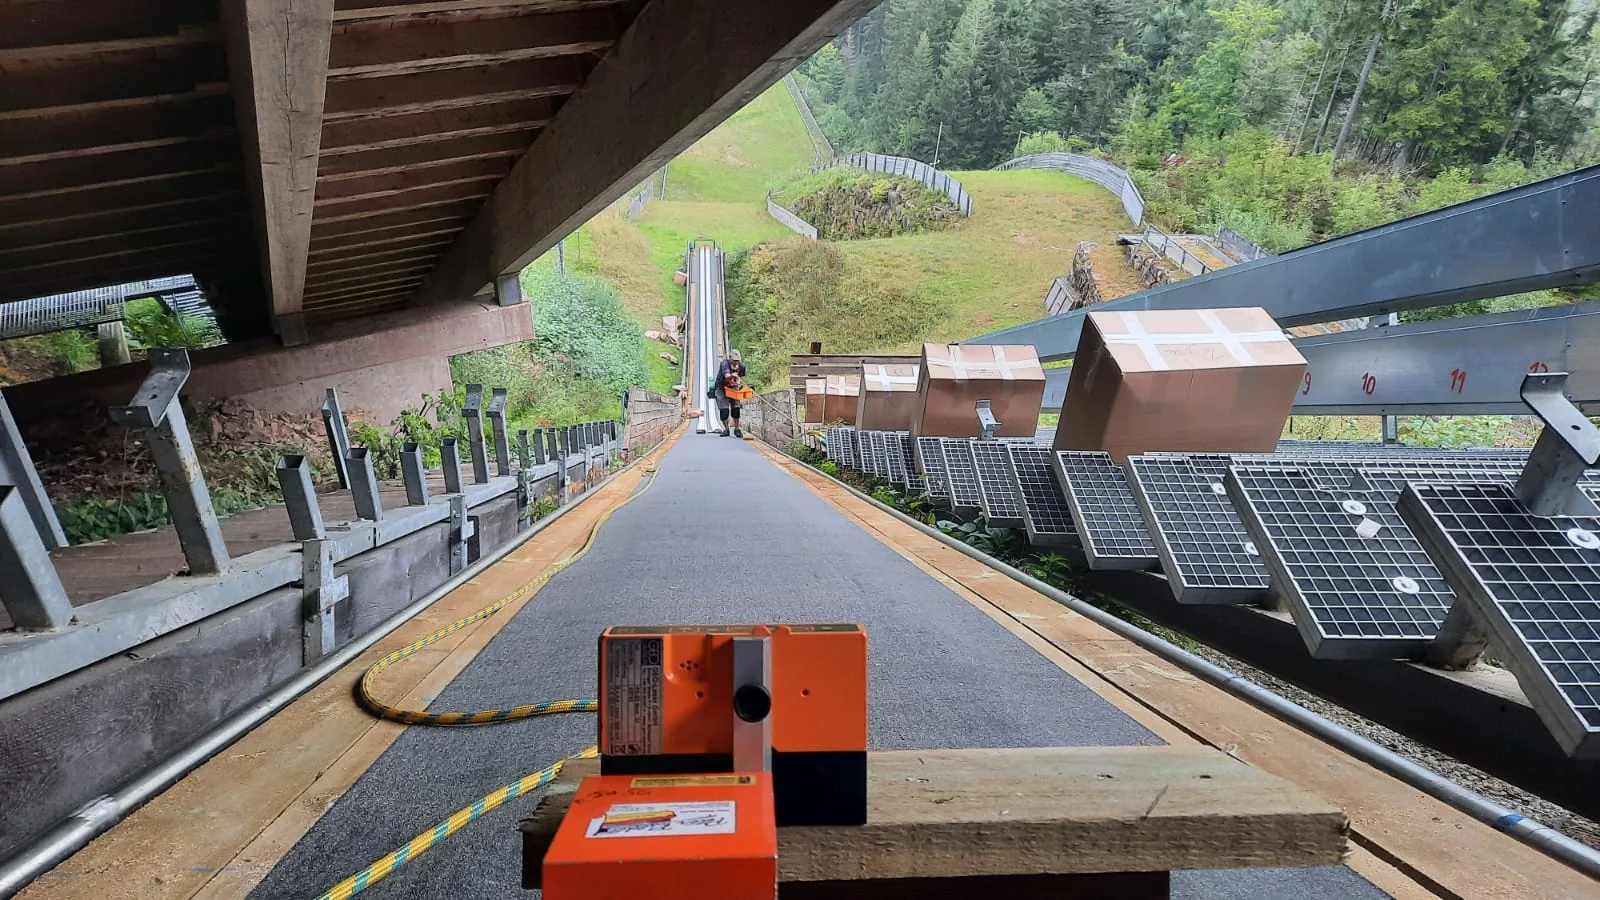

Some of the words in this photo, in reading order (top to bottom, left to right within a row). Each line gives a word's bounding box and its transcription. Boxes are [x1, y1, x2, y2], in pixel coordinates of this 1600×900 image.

[1302, 372, 1312, 396] 9
[1362, 372, 1376, 395] 10
[1450, 367, 1466, 394] 11
